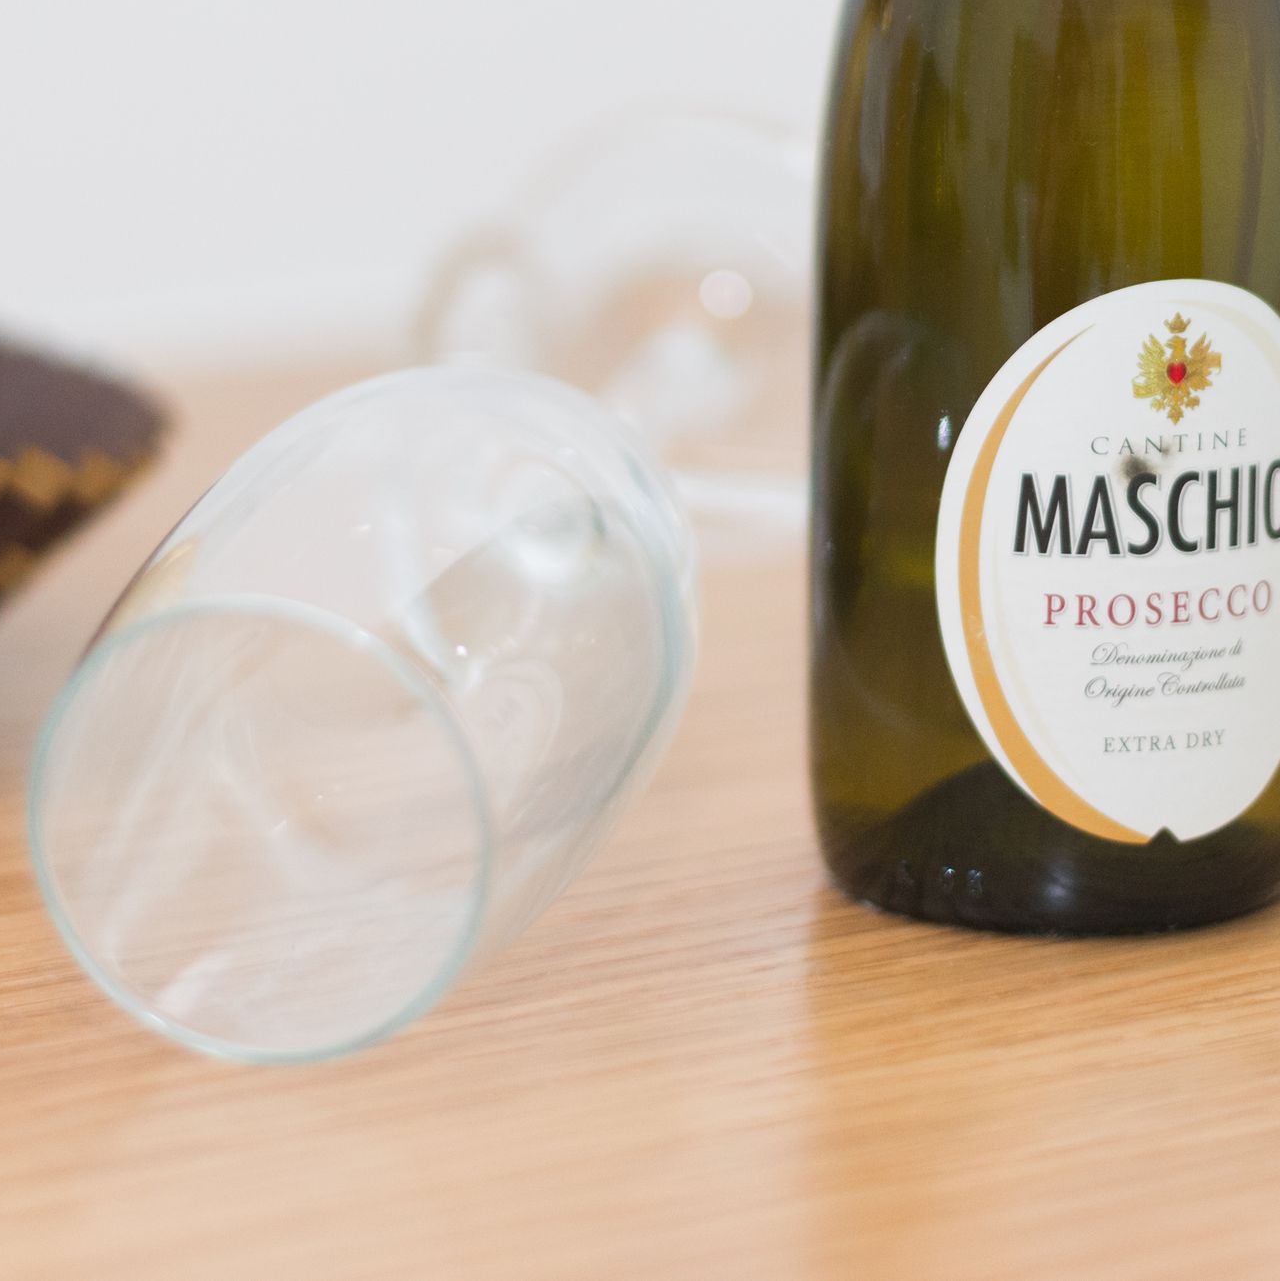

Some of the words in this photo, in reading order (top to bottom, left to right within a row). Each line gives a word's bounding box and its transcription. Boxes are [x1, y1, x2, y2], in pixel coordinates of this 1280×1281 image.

[1090, 428, 1247, 455] CANTINE
[1043, 580, 1272, 627] PROSECCO
[1090, 641, 1226, 671] Denominazione
[1228, 637, 1244, 656] di
[1084, 676, 1155, 708] Origine
[1156, 671, 1247, 696] Controllata
[1103, 734, 1177, 753] EXTRA
[1185, 728, 1226, 749] DRY
